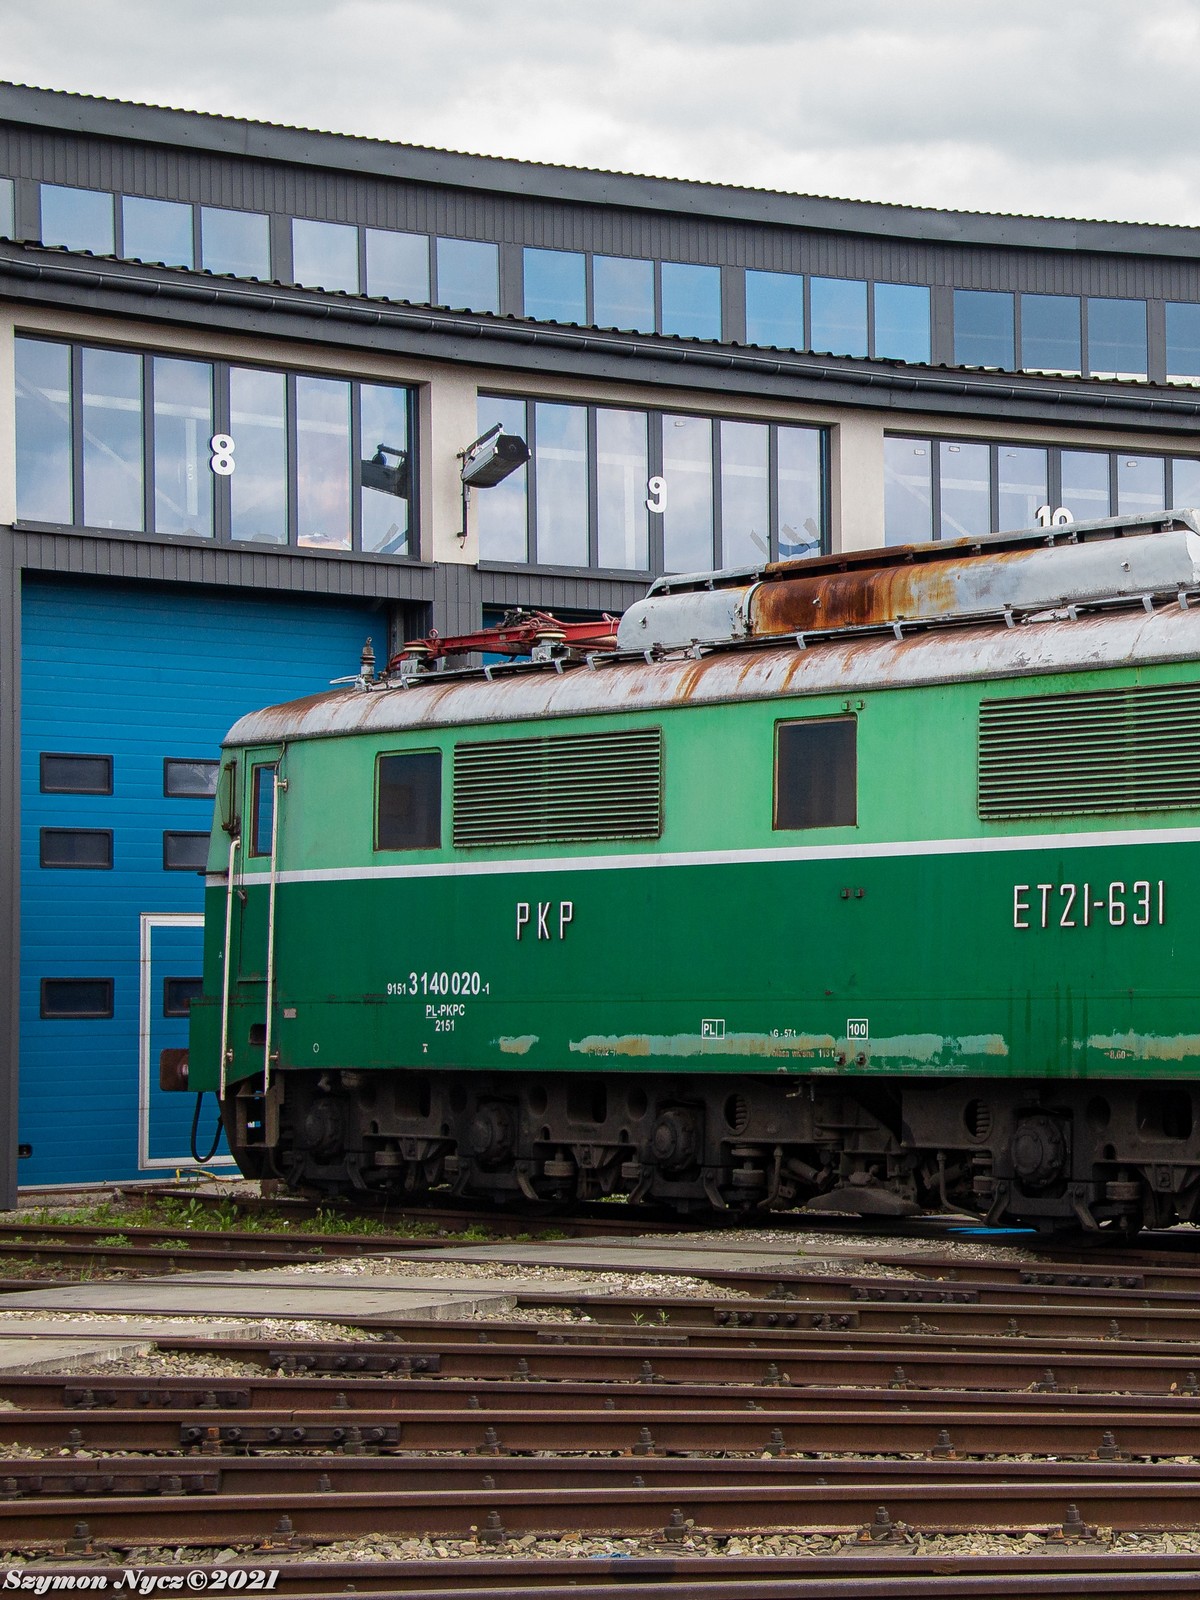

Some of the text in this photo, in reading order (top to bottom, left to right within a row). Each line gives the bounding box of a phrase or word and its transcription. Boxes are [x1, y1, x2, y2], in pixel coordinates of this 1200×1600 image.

[209, 433, 236, 476] 8
[645, 475, 668, 514] 9
[1012, 880, 1165, 928] ET21-631
[516, 901, 574, 941] PKP
[425, 1004, 466, 1019] PL-PKPC
[435, 1019, 455, 1032] 2151
[703, 1023, 716, 1035] PL
[849, 1023, 866, 1036] 100
